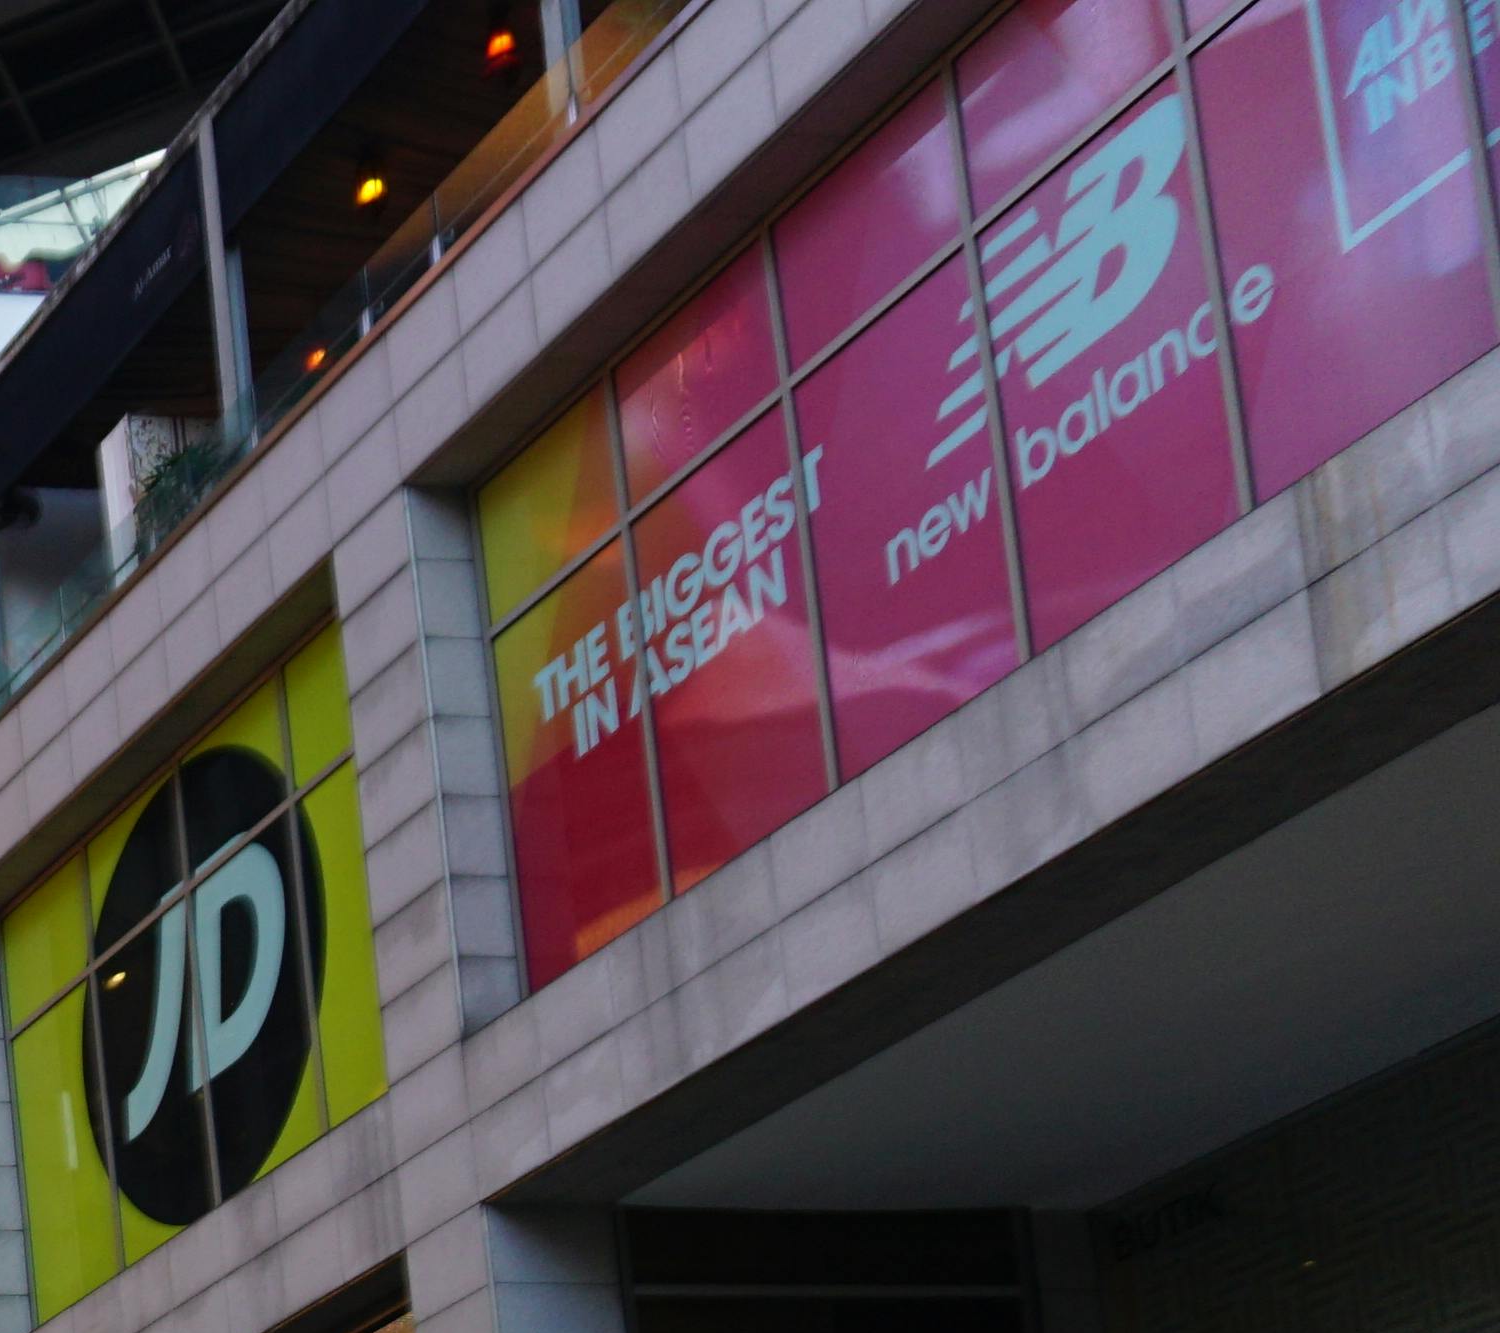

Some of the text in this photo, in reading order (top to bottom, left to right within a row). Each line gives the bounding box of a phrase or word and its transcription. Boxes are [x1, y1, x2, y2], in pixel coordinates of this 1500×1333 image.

[884, 262, 1275, 586] new balance
[532, 444, 823, 724] THE BIGGEST
[572, 545, 787, 760] IN ASEAN
[123, 832, 286, 1145] JD
